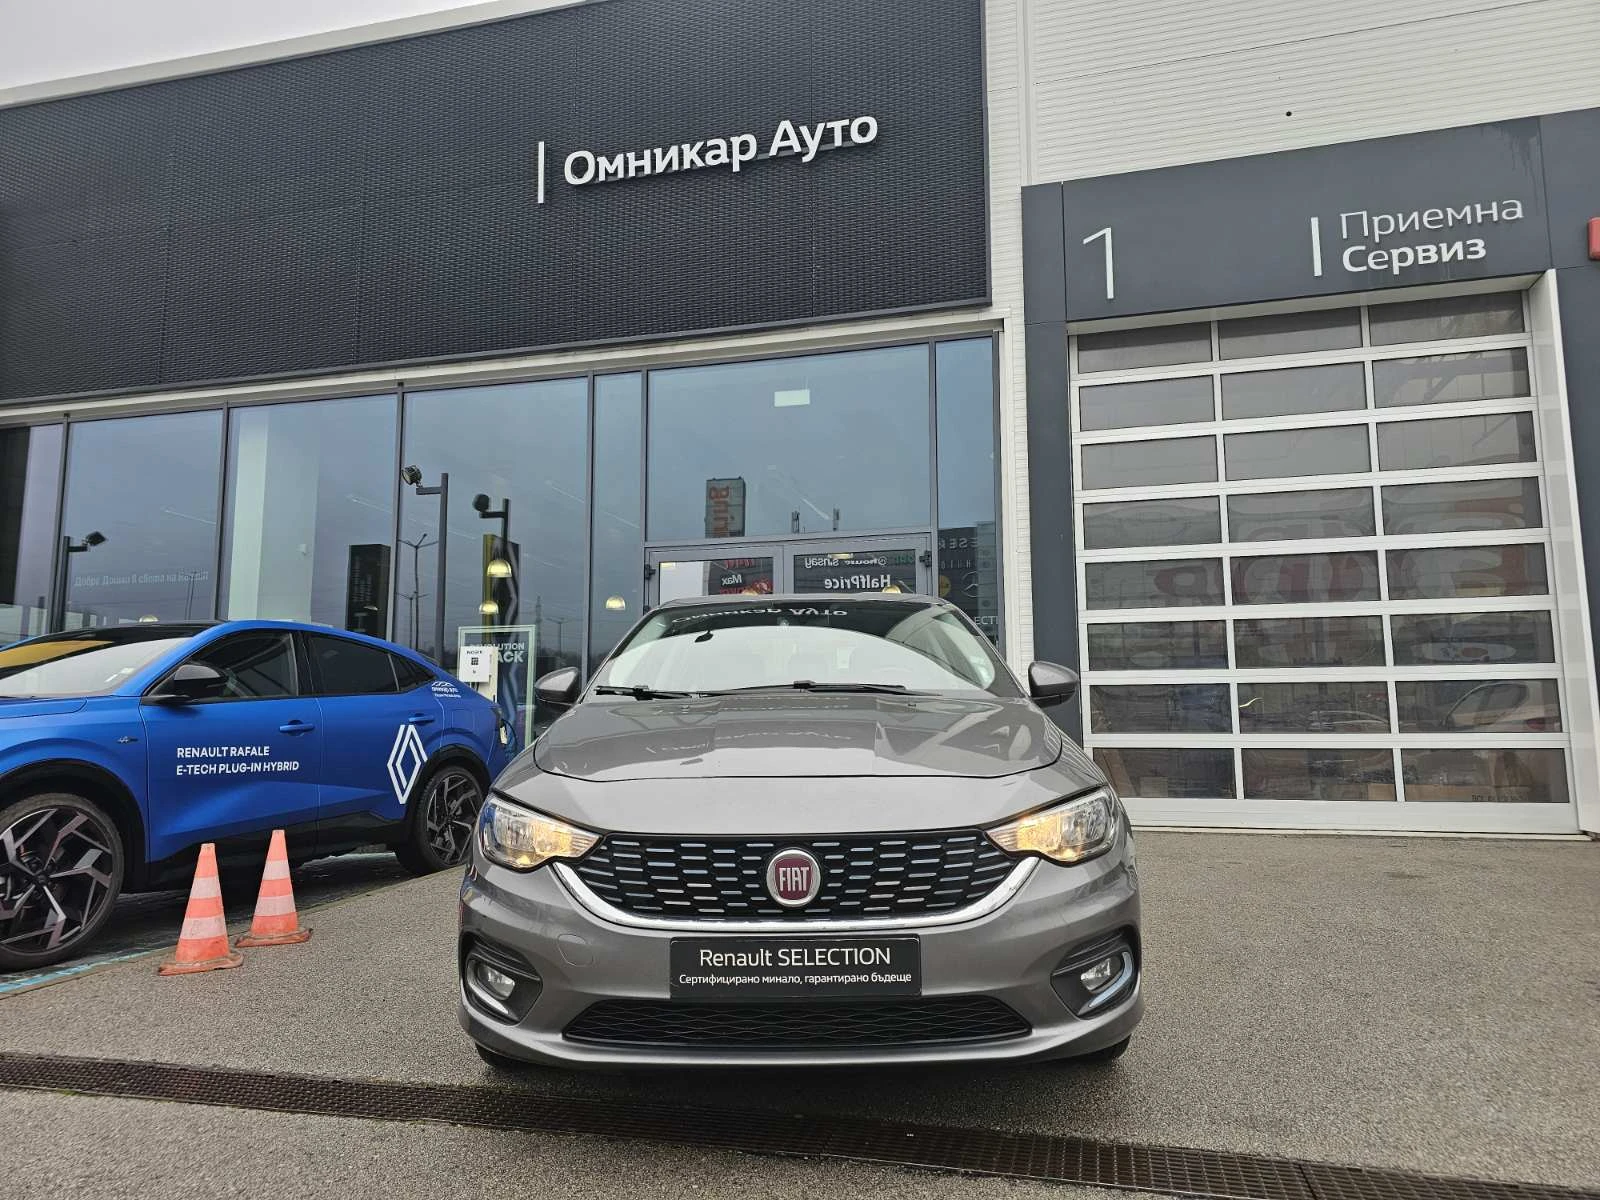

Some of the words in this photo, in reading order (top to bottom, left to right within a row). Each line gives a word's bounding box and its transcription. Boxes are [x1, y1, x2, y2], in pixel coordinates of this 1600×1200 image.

[563, 132, 758, 186] Омникар
[768, 115, 879, 163] Ауто
[1340, 199, 1524, 243] Приемна
[1082, 226, 1115, 300] 1
[1342, 238, 1487, 275] Сервиз
[177, 746, 228, 758] RENAULT
[230, 746, 270, 757] RAFALE
[176, 763, 217, 775] E-TECH
[218, 762, 261, 774] PLUG-IN
[263, 761, 299, 772] HYBRID
[779, 866, 809, 892] FIAT
[700, 949, 773, 967] Renault
[777, 947, 891, 967] SELECTION
[679, 973, 760, 986] Сертифицирано
[762, 974, 803, 985] минало,
[804, 974, 869, 985] гарантирано
[871, 972, 912, 984] бъдеще
